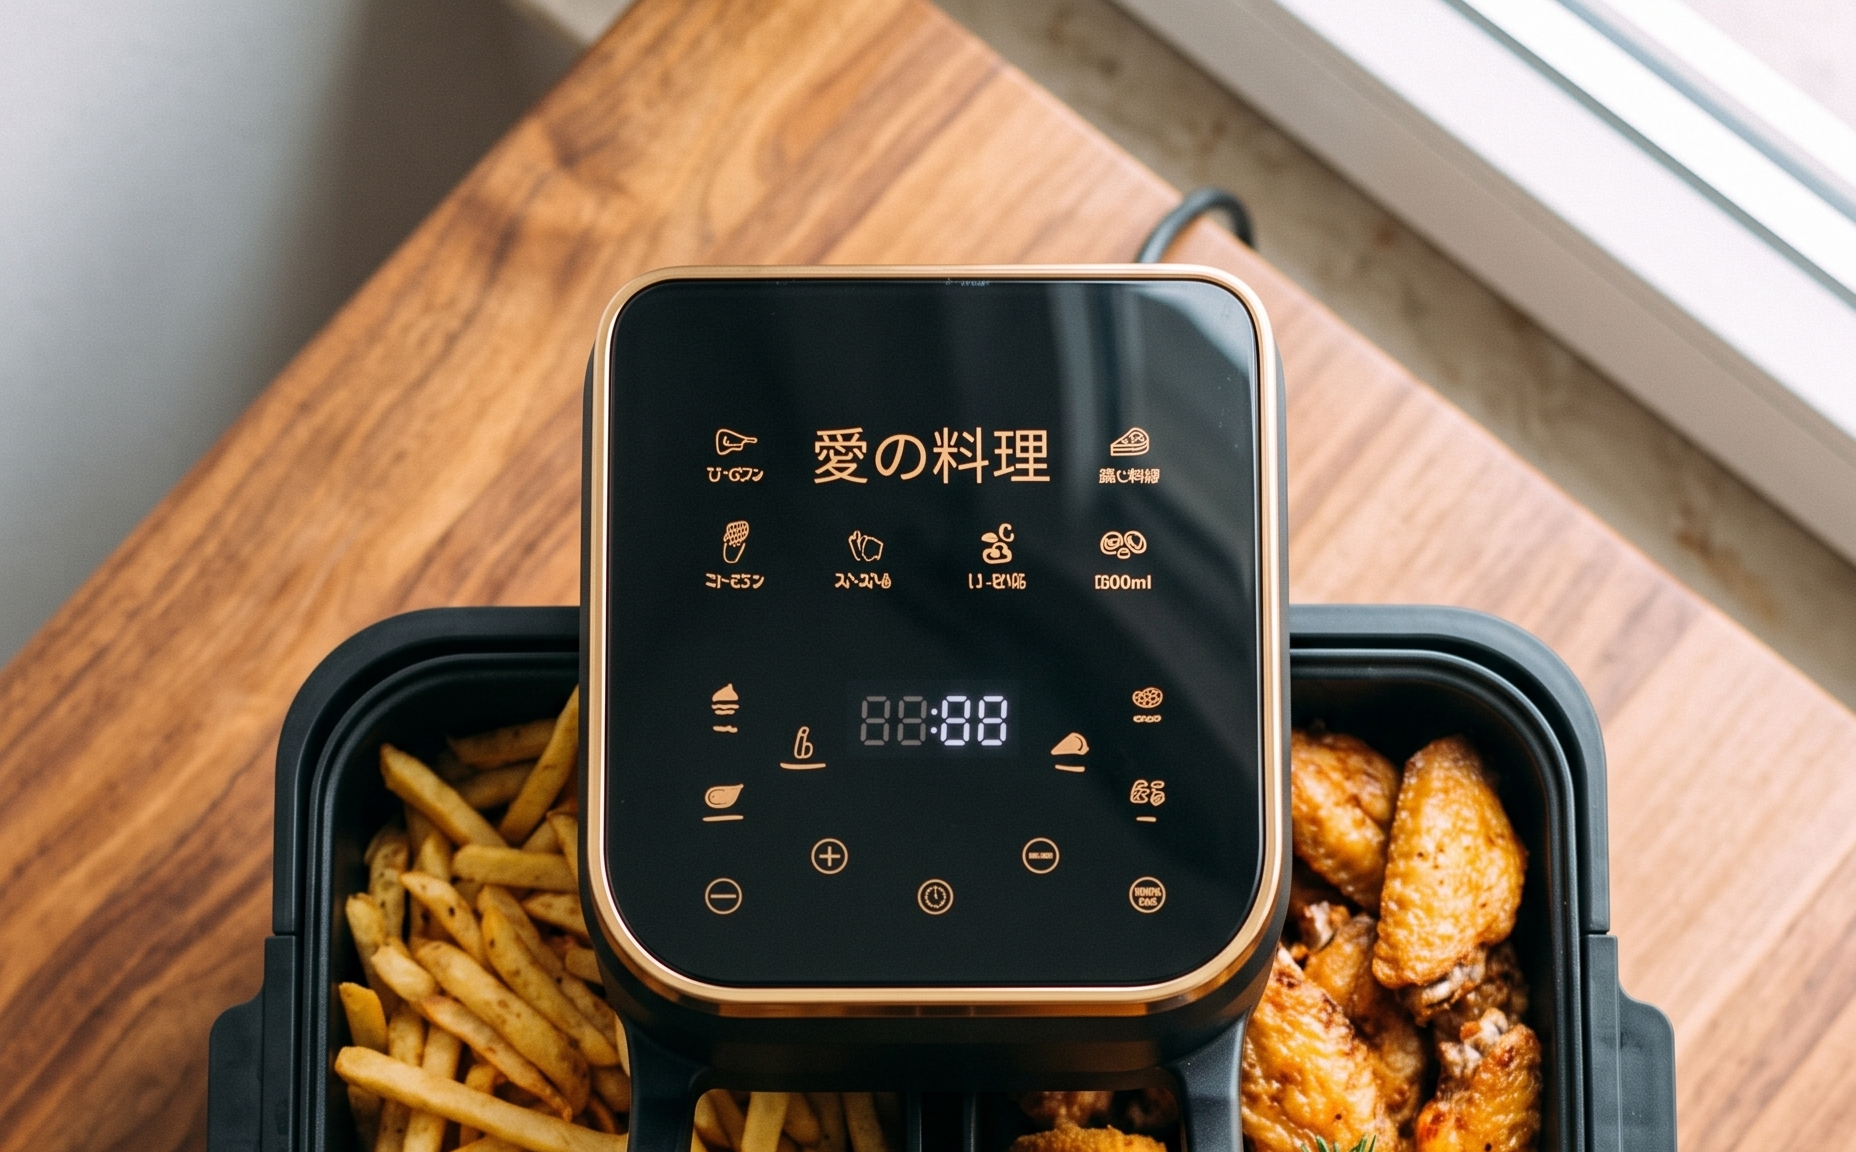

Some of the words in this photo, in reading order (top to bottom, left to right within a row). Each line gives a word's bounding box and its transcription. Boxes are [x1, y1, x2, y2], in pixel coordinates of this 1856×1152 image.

[814, 427, 1050, 484] 愛の料理
[860, 695, 1008, 746] 88:88
